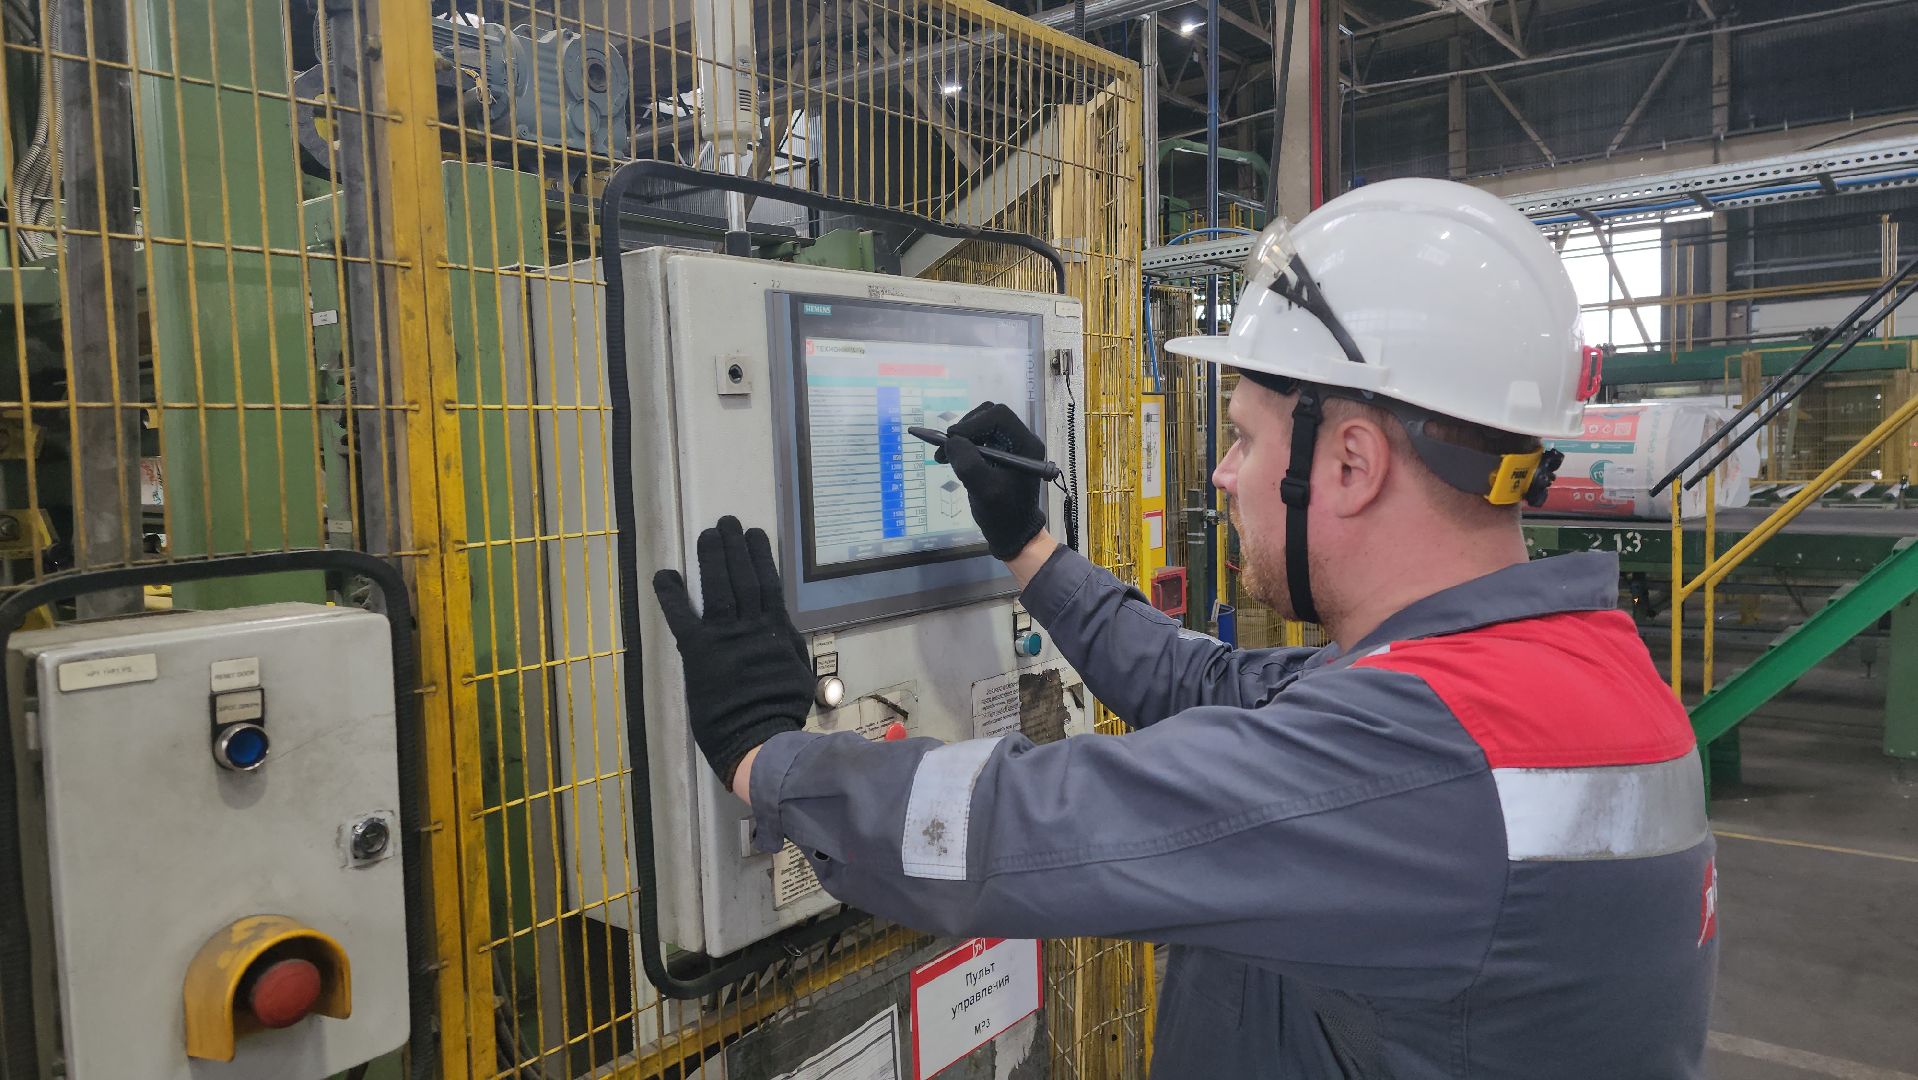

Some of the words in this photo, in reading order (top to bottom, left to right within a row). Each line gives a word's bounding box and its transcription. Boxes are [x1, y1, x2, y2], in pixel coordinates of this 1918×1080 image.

[804, 304, 832, 314] SIEMENS
[965, 962, 995, 986] Пульт
[951, 974, 1010, 1019] управления
